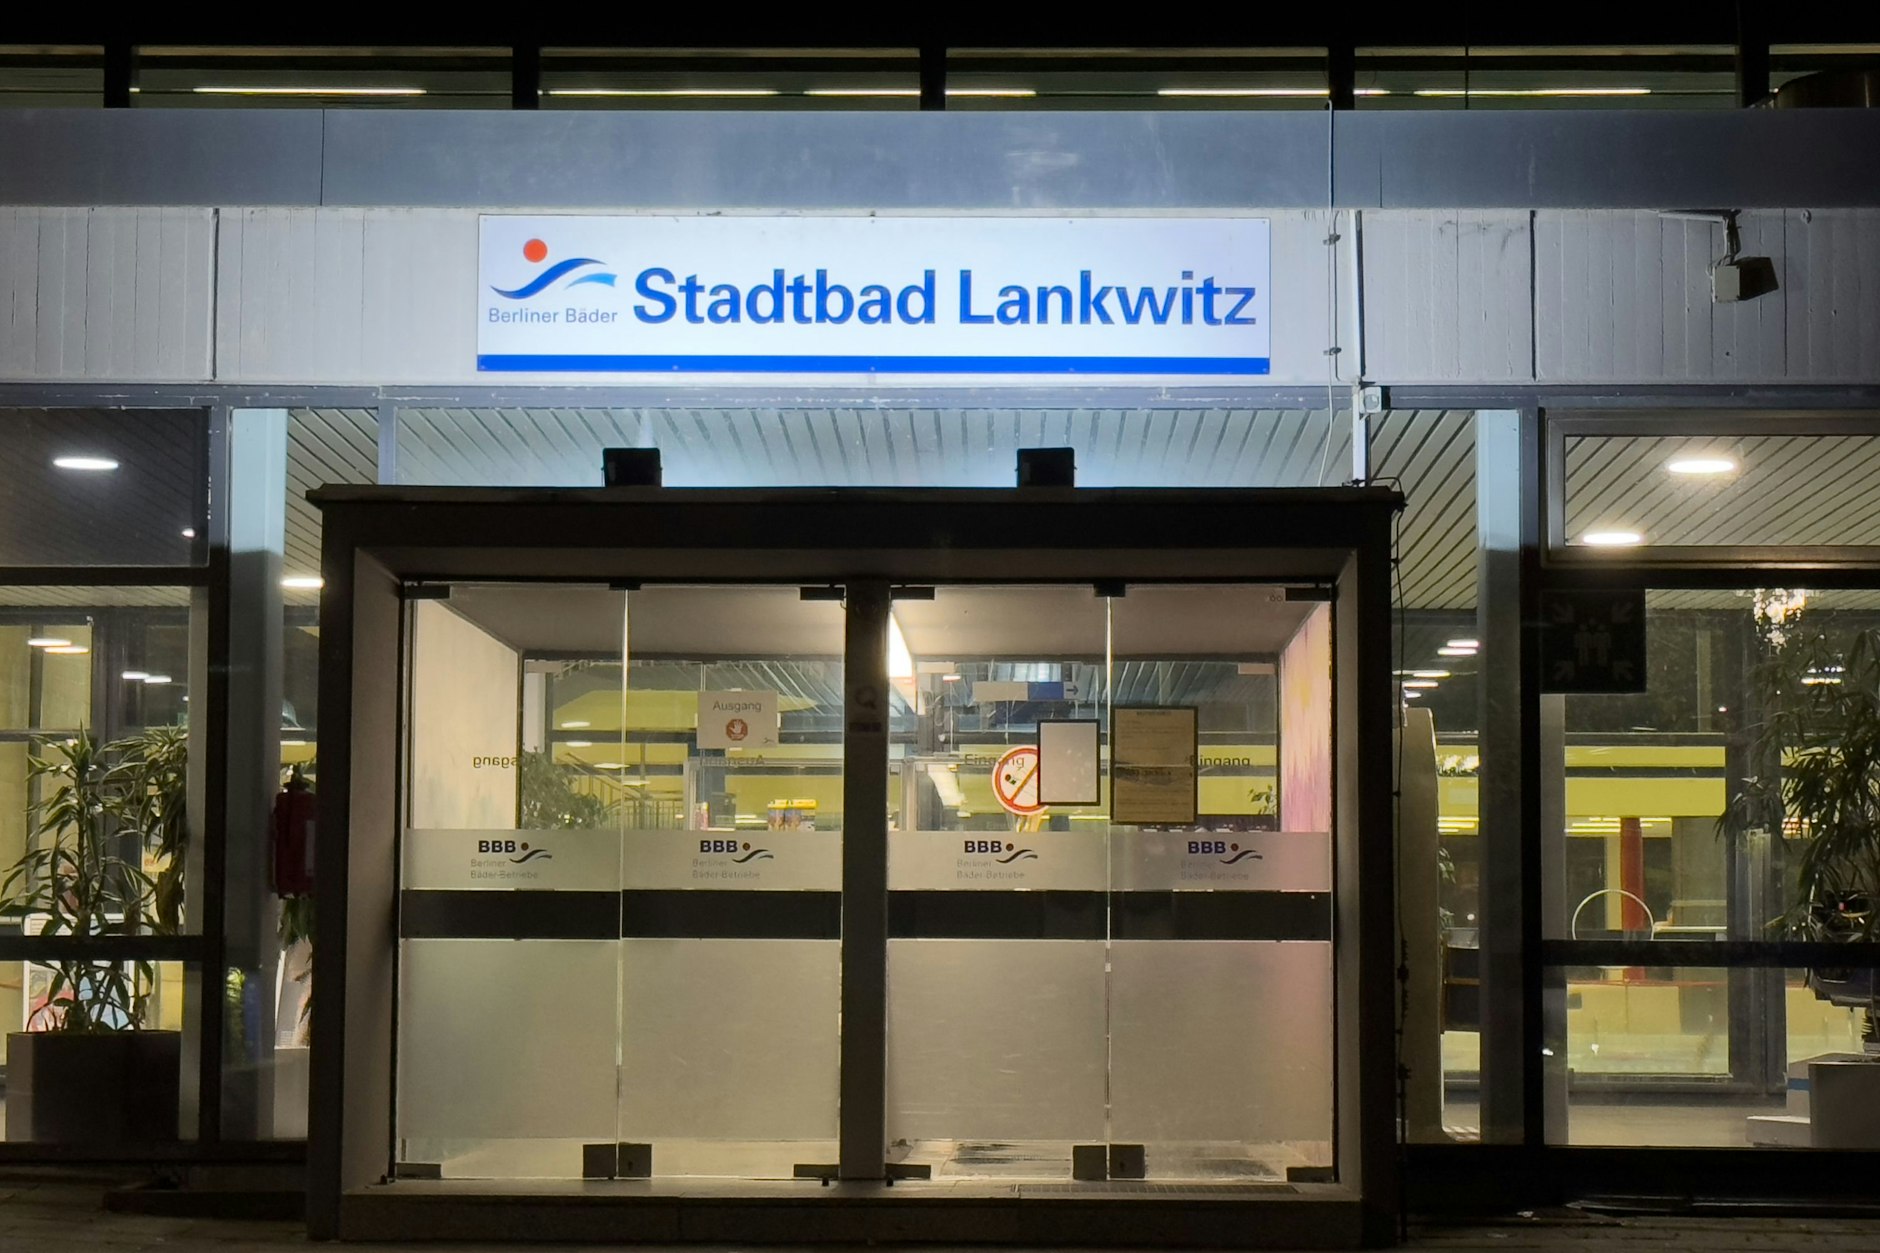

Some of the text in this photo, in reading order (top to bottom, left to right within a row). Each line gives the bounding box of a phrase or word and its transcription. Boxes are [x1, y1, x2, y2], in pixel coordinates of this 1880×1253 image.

[633, 267, 1256, 326] Stadtbad Lankwitz
[488, 308, 618, 323] Berliner Bäder
[712, 701, 762, 712] Ausgang
[478, 840, 516, 853] BBB
[700, 840, 738, 853] BBB
[964, 840, 1002, 853] BBB
[1188, 841, 1226, 854] BBB
